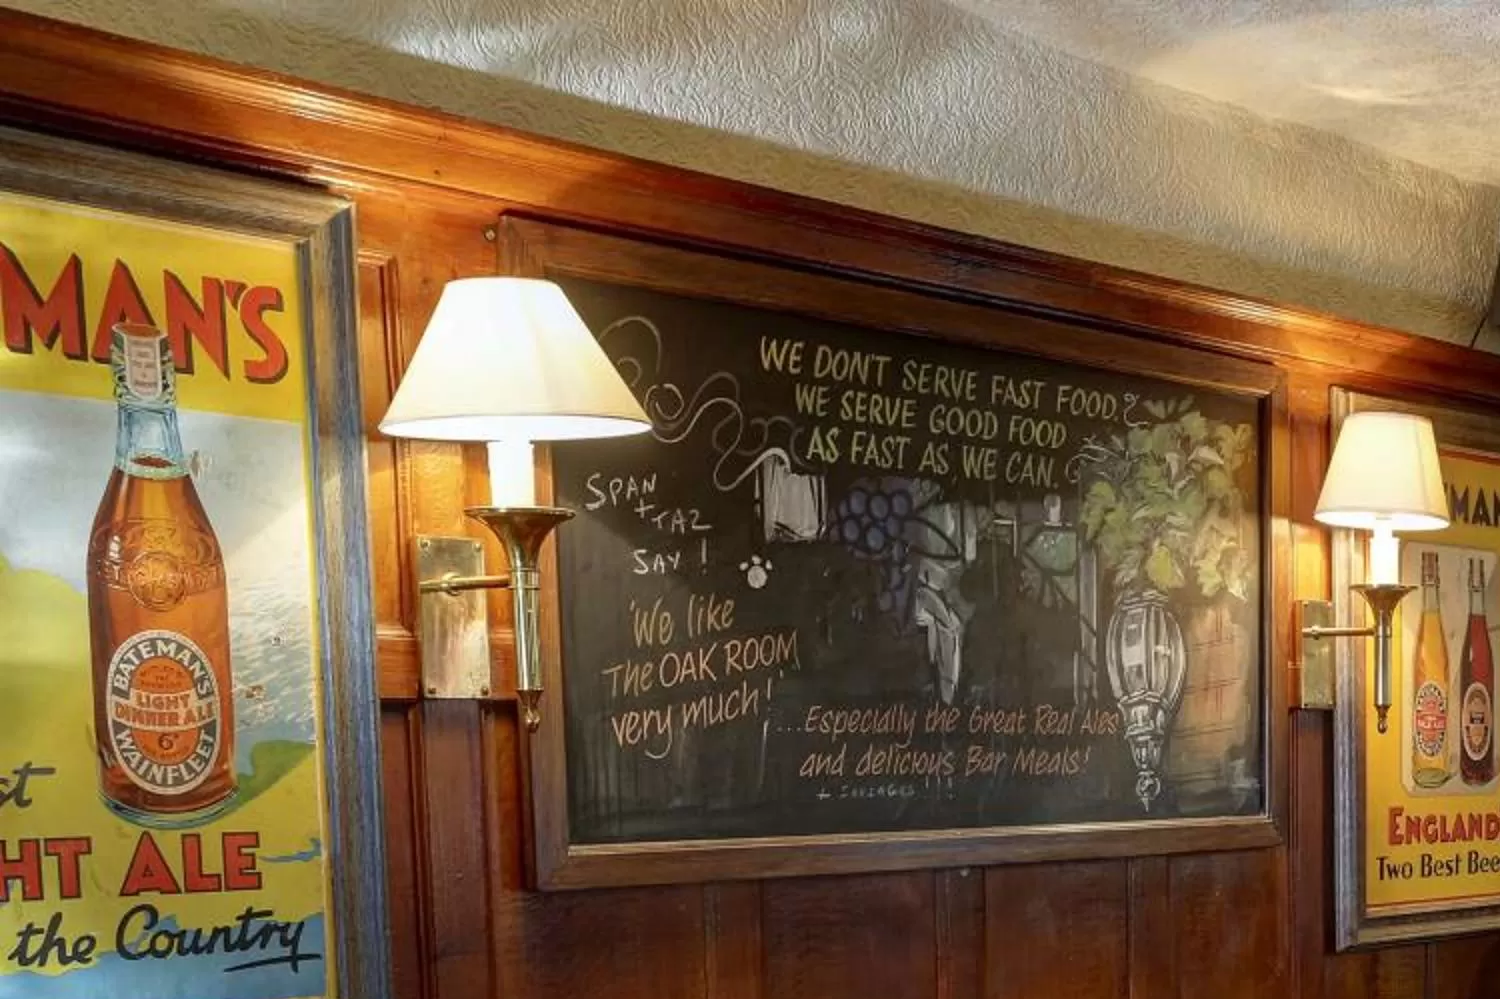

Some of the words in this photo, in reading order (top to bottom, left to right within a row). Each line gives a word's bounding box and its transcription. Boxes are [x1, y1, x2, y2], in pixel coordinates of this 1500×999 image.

[760, 335, 805, 375] WE
[813, 345, 892, 387] DON'T
[902, 359, 979, 402] SERVE
[990, 374, 1047, 411] FAST
[1056, 385, 1118, 421] FOOD.
[795, 383, 831, 417] WE
[840, 390, 917, 429] SERVE
[929, 403, 998, 441] GOOD
[1009, 415, 1067, 449] FOOD
[807, 426, 841, 463] AS
[850, 431, 912, 470] FAST
[919, 441, 951, 475] AS
[961, 445, 998, 481] WE
[1005, 451, 1058, 489] CAN.
[585, 472, 656, 511] SPAN
[632, 549, 681, 574] SAY
[687, 593, 735, 638] like
[113, 639, 212, 697] BATEMAN'S
[659, 642, 718, 687] OAK
[724, 628, 800, 677] ROOM
[135, 692, 190, 710] LIGHT
[924, 702, 960, 734] the
[969, 705, 1028, 736] Great
[1034, 704, 1075, 736] Real
[1079, 707, 1118, 735] Ales
[116, 728, 214, 785] WAINFLEET
[611, 704, 673, 759] very
[799, 743, 847, 777] and
[855, 737, 955, 777] delicious
[964, 745, 1006, 777] Bar
[119, 830, 262, 897] ALE
[1376, 856, 1413, 881] Two
[1421, 853, 1462, 878] Best
[8, 911, 97, 967] the
[116, 904, 306, 973] Country
